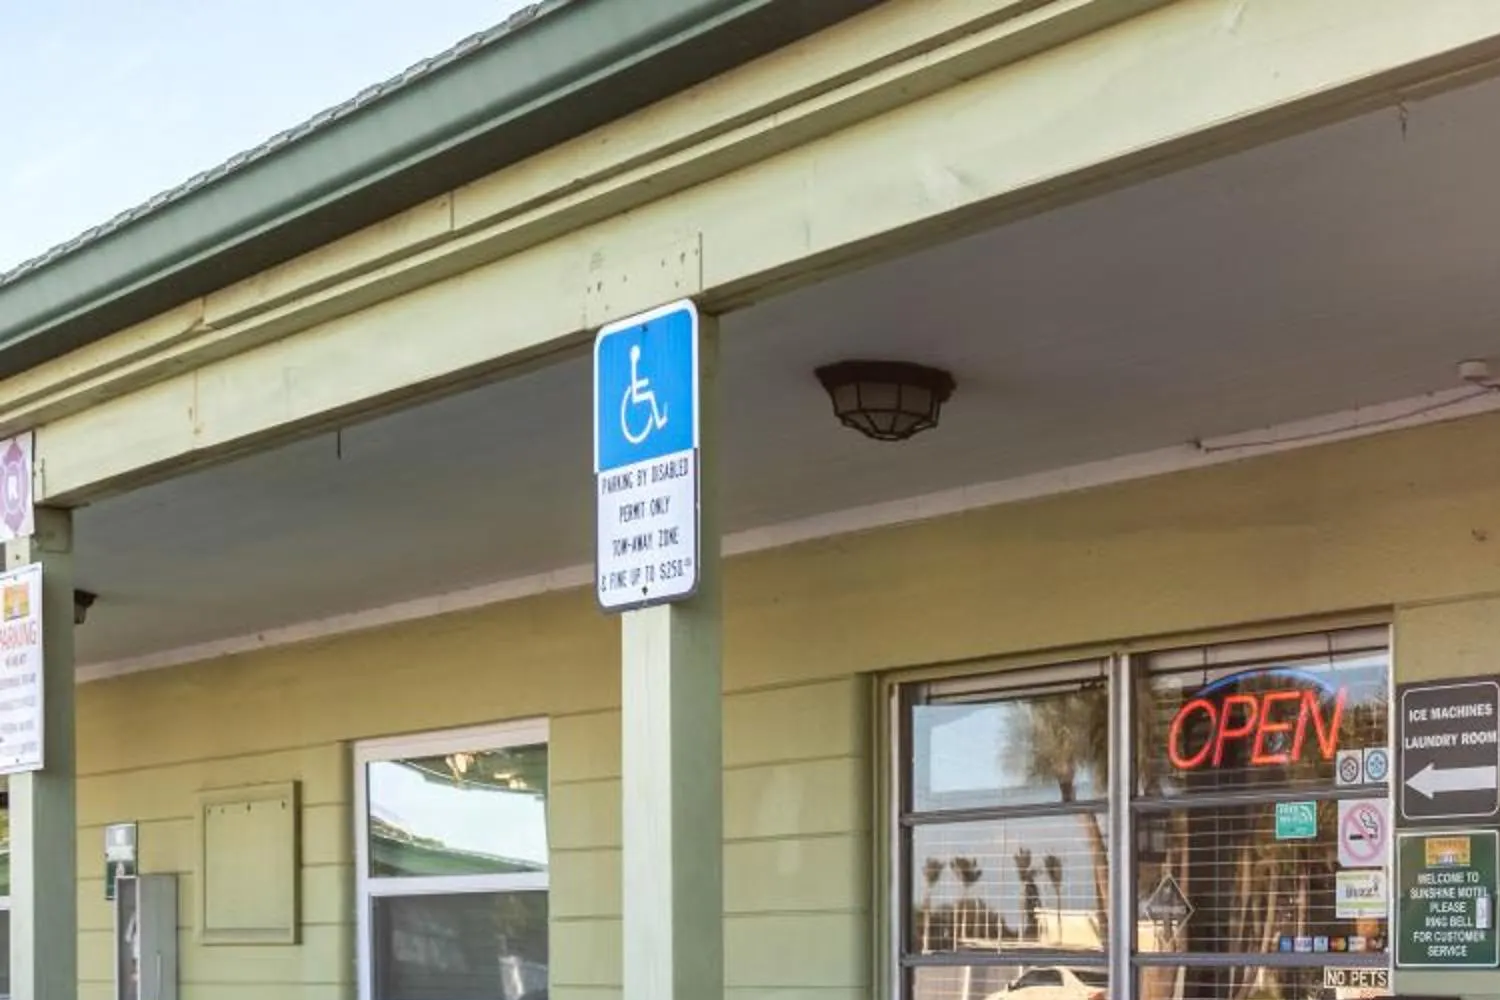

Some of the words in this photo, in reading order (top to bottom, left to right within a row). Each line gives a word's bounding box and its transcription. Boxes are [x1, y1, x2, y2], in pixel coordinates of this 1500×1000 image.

[601, 471, 633, 494] PARKING
[637, 468, 648, 487] BY
[651, 457, 688, 483] DISABLED
[619, 501, 645, 524] PERMIT
[650, 496, 670, 517] ONLY
[612, 532, 653, 557] TOW-AWAY
[657, 526, 679, 548] ZONE
[610, 569, 627, 590] FINE
[645, 564, 655, 583] TO
[1409, 708, 1428, 723] ICE
[1430, 703, 1493, 720] MACHINES
[1168, 685, 1347, 769] OPEN
[1405, 732, 1459, 750] LAUNDRY
[1461, 730, 1497, 745] ROOM
[1417, 872, 1464, 885] WELCOME
[1466, 871, 1479, 883] TO
[1409, 887, 1456, 900] SUNSHINE
[1457, 886, 1488, 899] MOTEL
[1429, 901, 1466, 913] PLEASE
[1425, 916, 1448, 928] RING
[1449, 916, 1473, 927] BELL
[1413, 931, 1432, 942] FOR
[1433, 930, 1487, 942] CUSTOMER
[1427, 945, 1468, 957] SERVICE
[1327, 969, 1345, 985] NO
[1351, 970, 1387, 986] PETS
